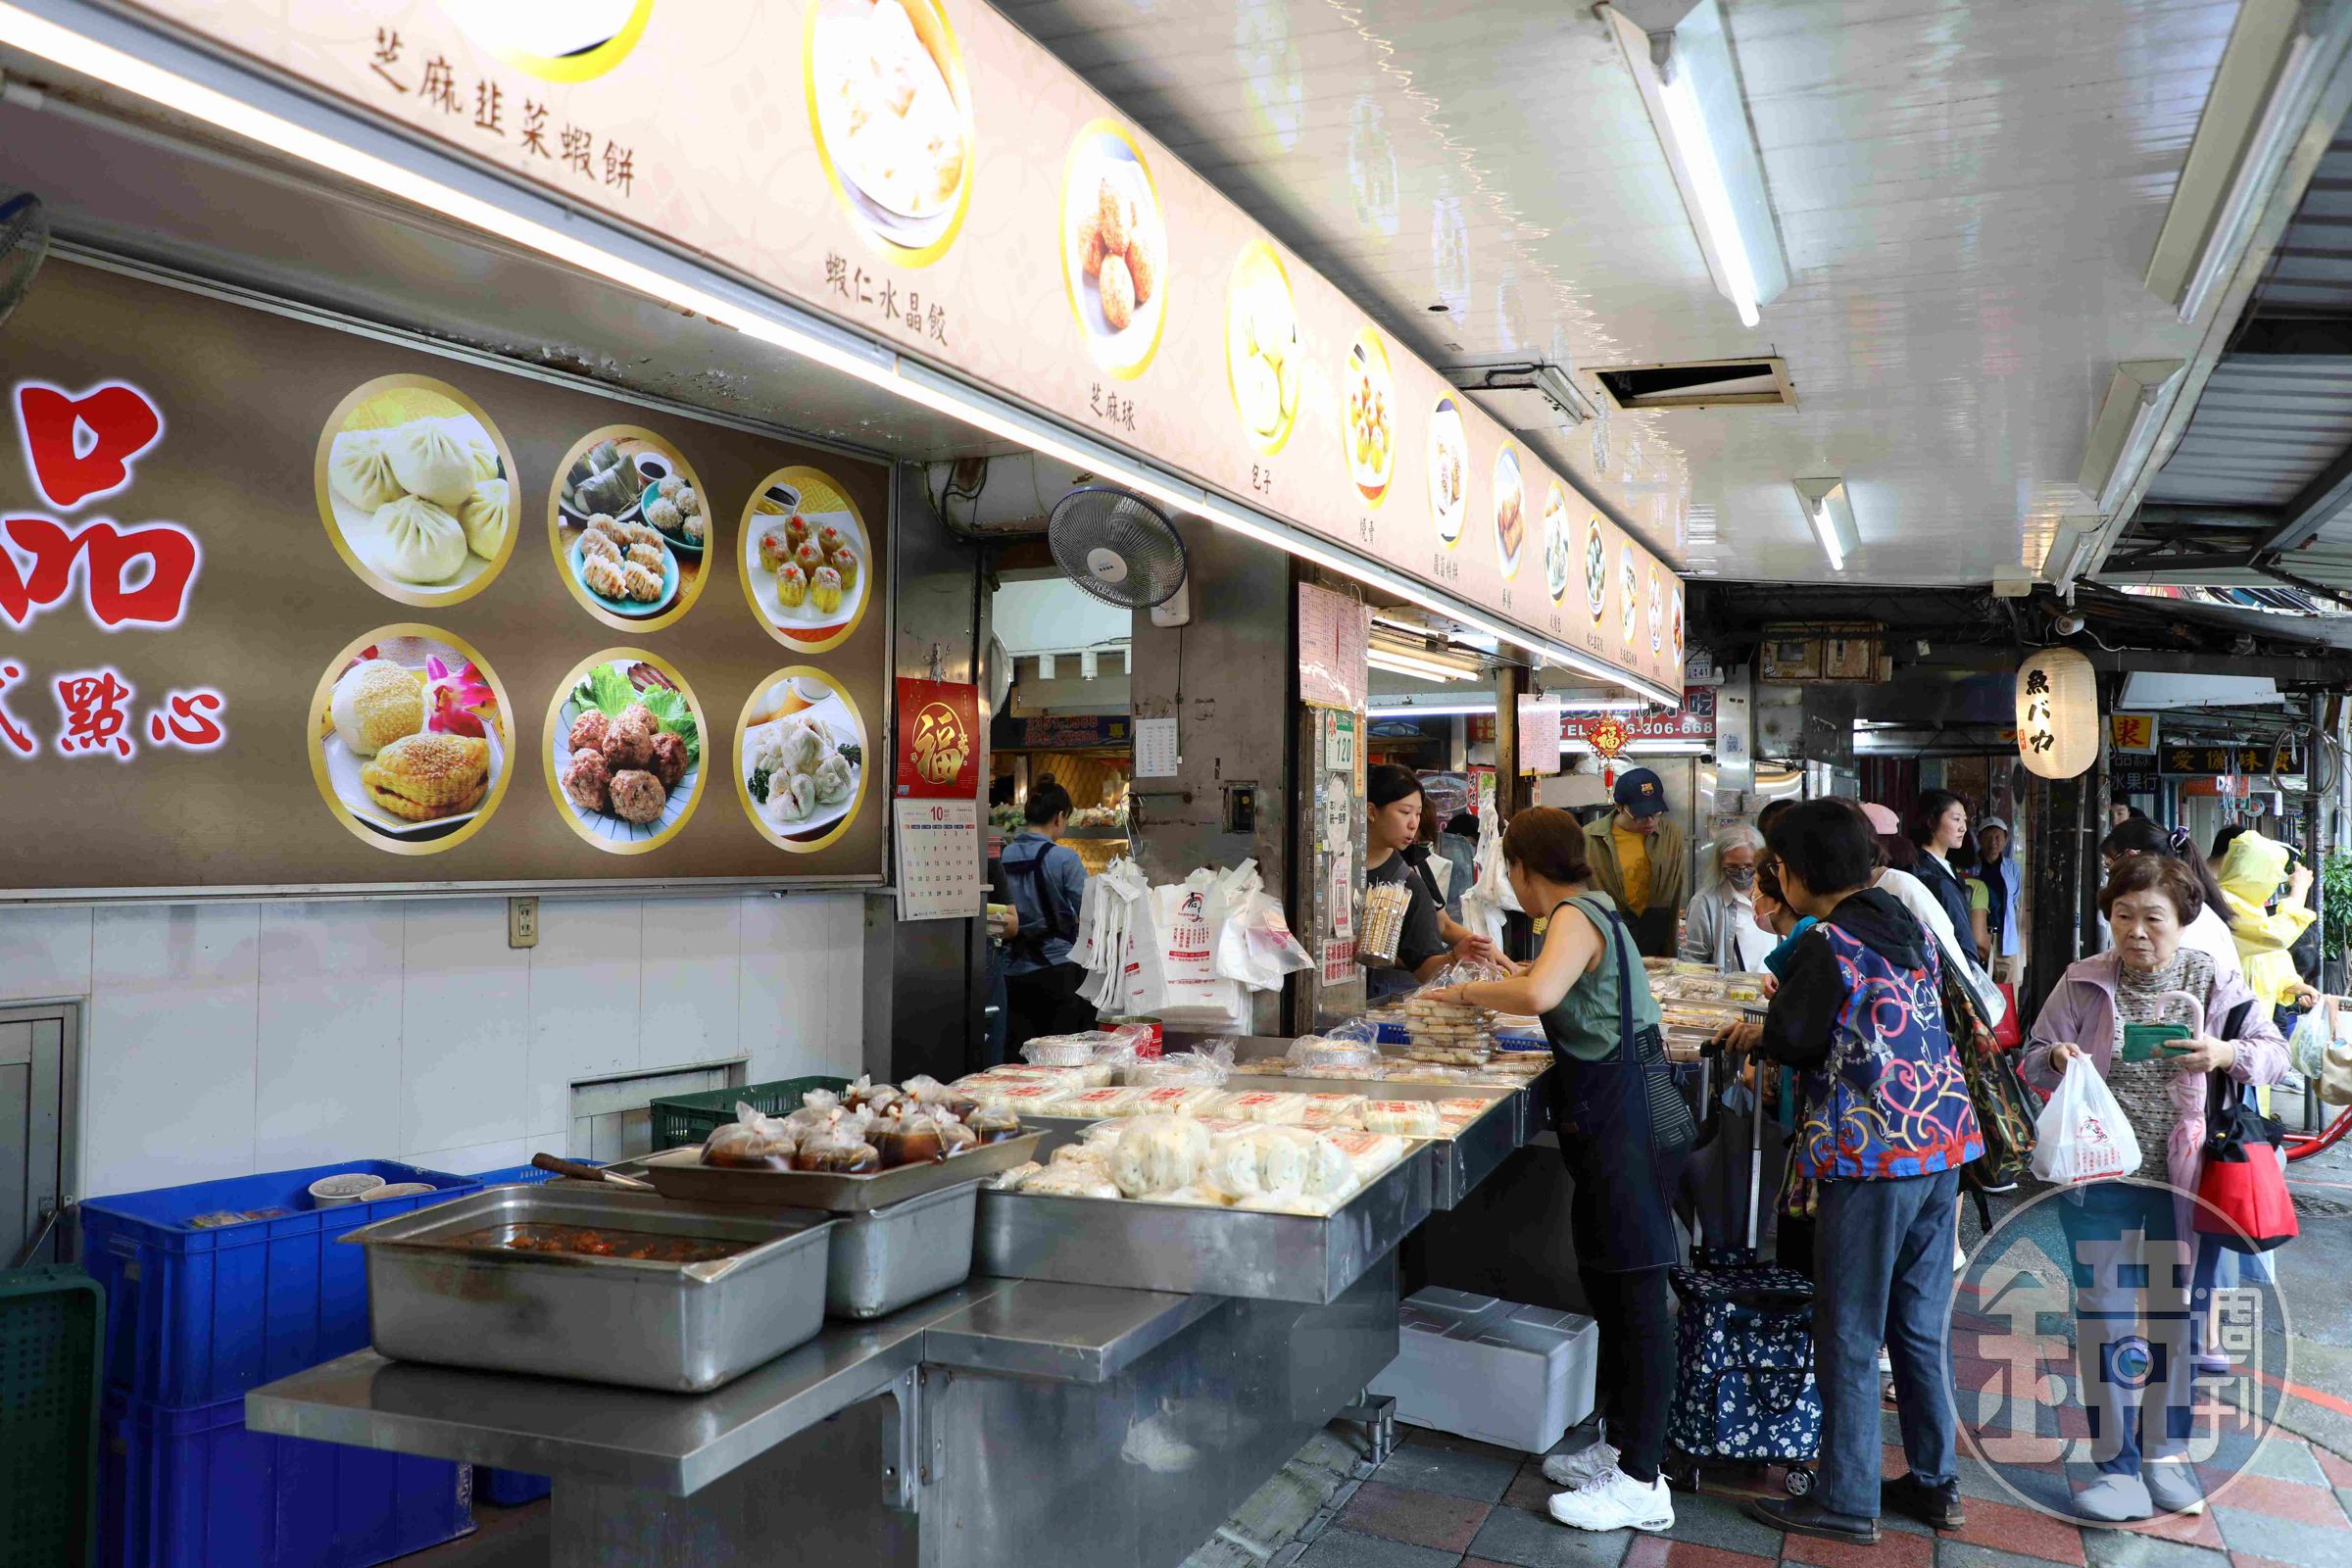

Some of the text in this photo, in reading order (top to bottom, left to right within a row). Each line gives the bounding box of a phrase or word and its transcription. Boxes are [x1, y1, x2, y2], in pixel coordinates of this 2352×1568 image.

[368, 25, 635, 198] 芝麻韭菜蝦餅
[824, 252, 949, 348] 蝦仁水晶餃
[1091, 381, 1136, 432] 芝麻球
[1250, 463, 1272, 495] 包子
[1625, 722, 1713, 735] 6-306-668
[2026, 669, 2055, 755] 魚バカ
[913, 711, 961, 787] 福
[1337, 737, 1351, 762] 120
[1596, 725, 1621, 749] 福
[930, 806, 943, 821] 10
